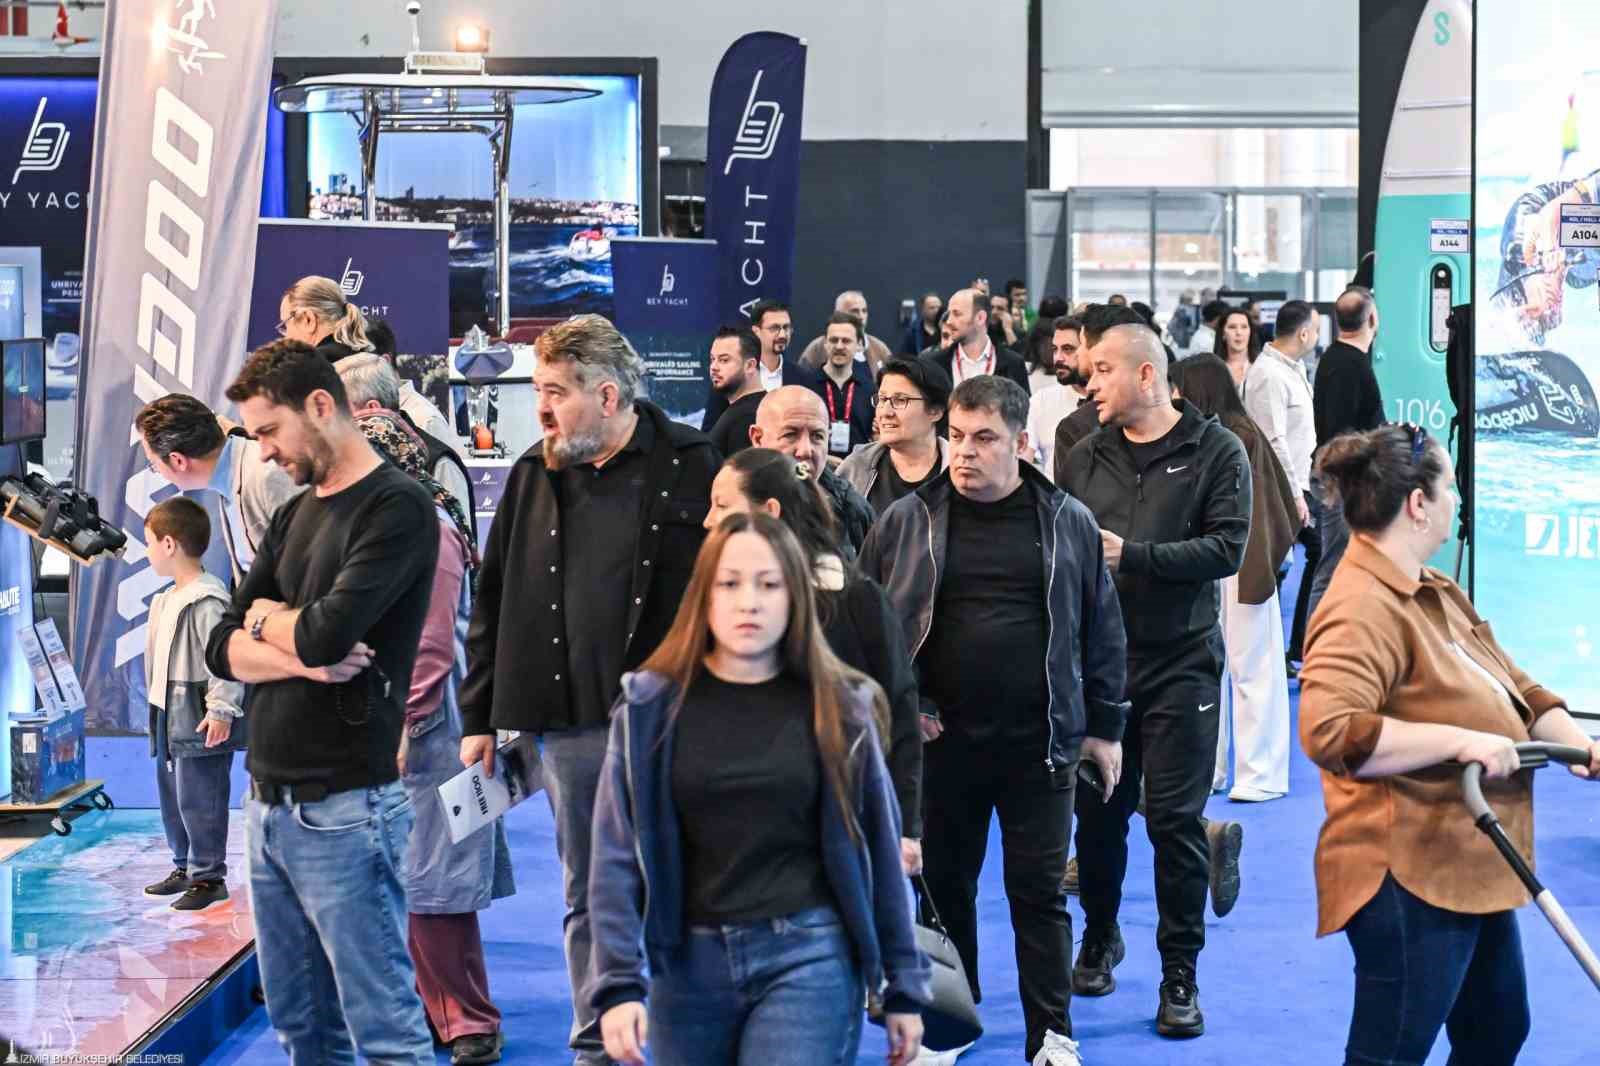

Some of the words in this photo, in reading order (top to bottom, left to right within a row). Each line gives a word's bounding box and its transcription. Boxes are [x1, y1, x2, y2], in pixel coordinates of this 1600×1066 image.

[27, 191, 90, 209] YAC
[1571, 230, 1598, 240] A104
[1439, 239, 1459, 247] A144
[739, 185, 768, 318] ACHT
[361, 305, 389, 316] CHT
[1565, 516, 1600, 559] JE
